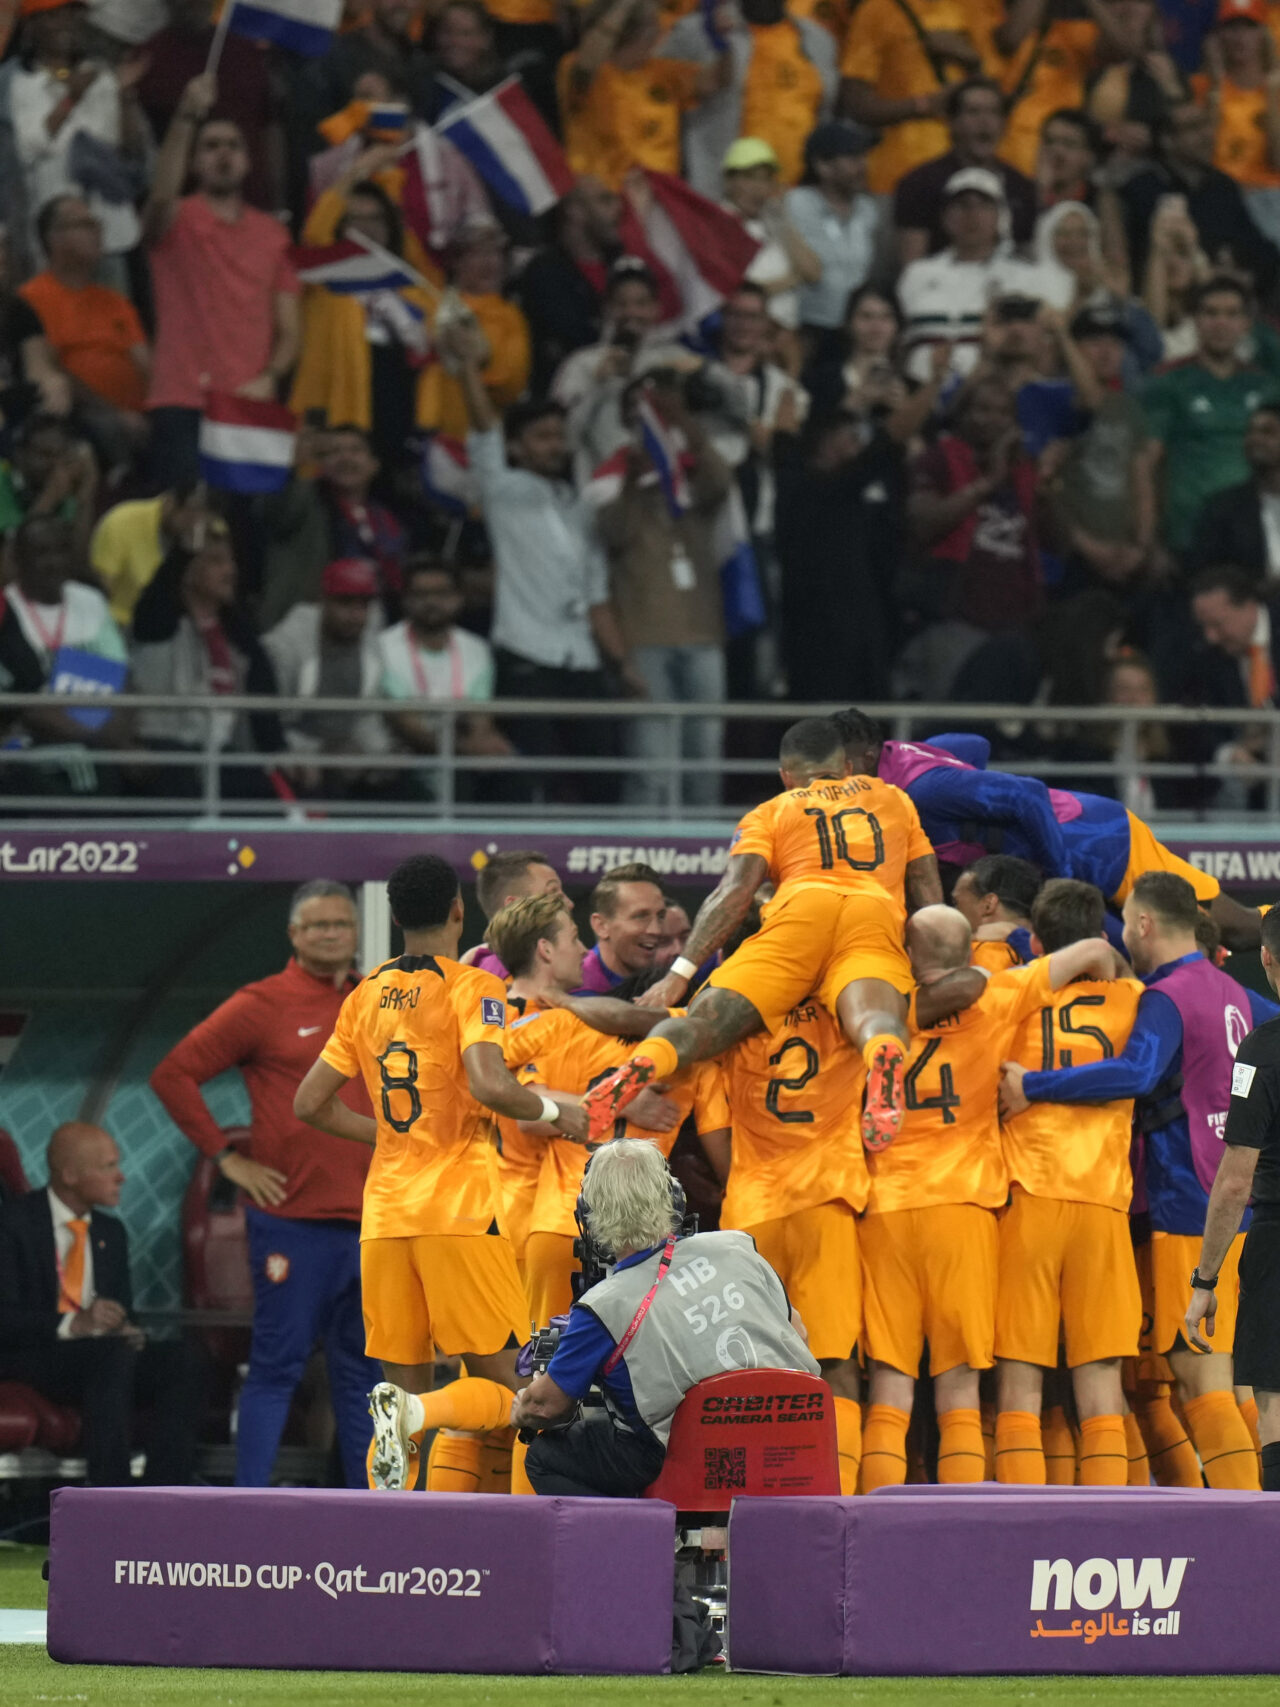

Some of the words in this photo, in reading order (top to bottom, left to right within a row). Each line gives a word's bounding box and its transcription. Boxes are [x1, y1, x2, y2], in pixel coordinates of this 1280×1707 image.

[804, 807, 885, 872] 10
[566, 846, 731, 875] #FIFAWorld
[1188, 851, 1246, 880] FIFA
[1041, 995, 1114, 1071] 15
[377, 1041, 422, 1133] 8
[766, 1036, 819, 1124] 2
[1207, 1111, 1229, 1127] FIF
[666, 1256, 718, 1297] HB
[683, 1282, 746, 1335] 526
[702, 1392, 824, 1412] ORBITER
[700, 1413, 773, 1425] CAMERA
[777, 1411, 825, 1423] SEATS
[115, 1560, 164, 1585] FIFA
[166, 1562, 251, 1588] WORLD
[256, 1565, 302, 1589] CUP
[1132, 1611, 1150, 1635] is
[1153, 1611, 1181, 1635] all
